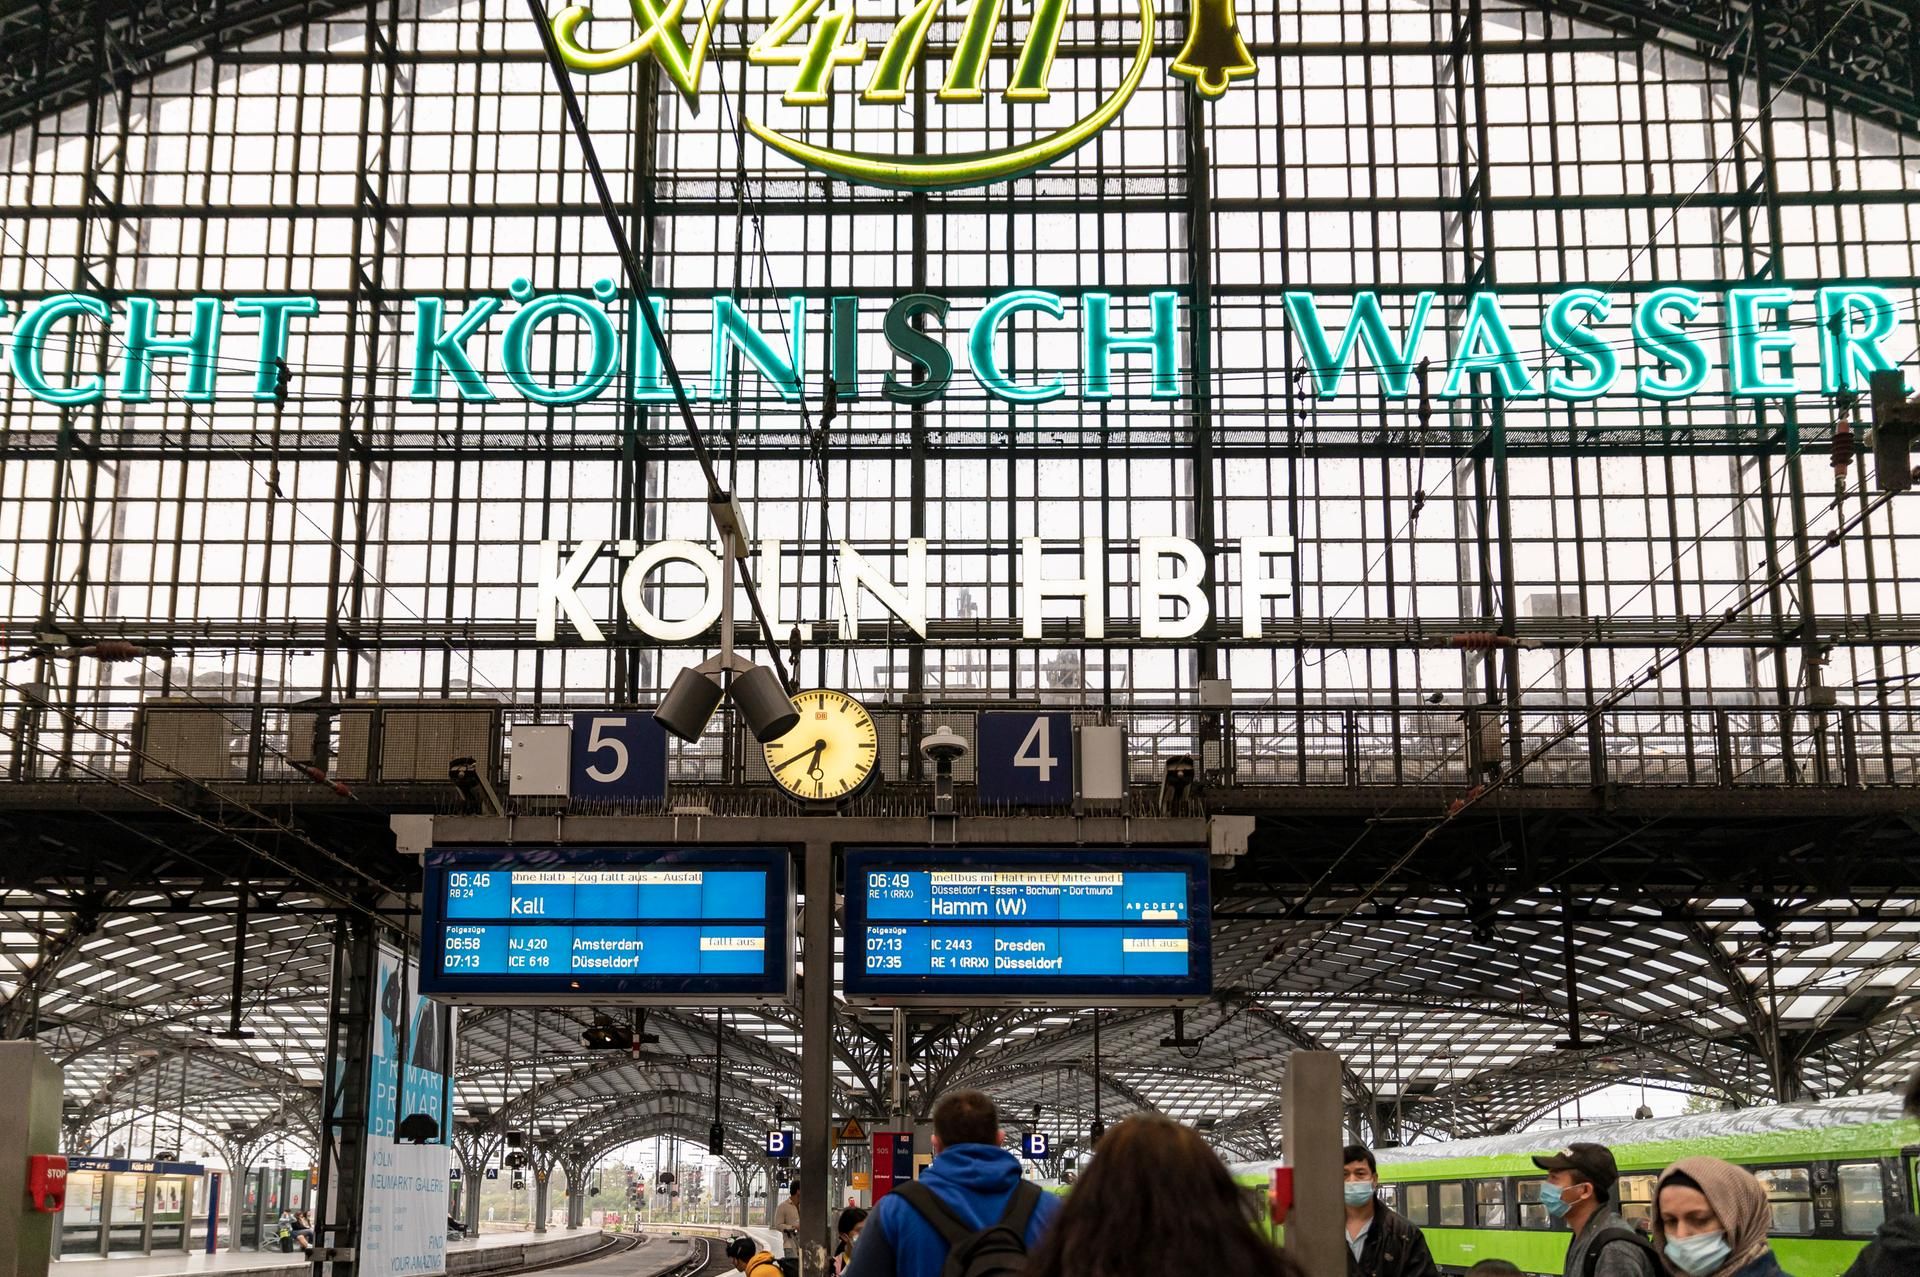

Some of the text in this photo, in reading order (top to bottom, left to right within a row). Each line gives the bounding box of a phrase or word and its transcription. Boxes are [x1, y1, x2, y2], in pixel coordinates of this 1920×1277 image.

[0, 277, 1915, 407] CHT KÖLNISCH WASSER
[535, 536, 1294, 642] KÖLN HBF
[585, 717, 629, 783] 5
[1013, 716, 1058, 781] 4
[450, 873, 490, 888] 06:46
[578, 873, 597, 883] Zug
[869, 873, 910, 888] 06:49
[981, 874, 998, 882] mit
[1002, 873, 1025, 882] Halt
[1027, 874, 1037, 882] in
[1062, 873, 1091, 882] Mitte
[1094, 873, 1114, 882] und
[450, 889, 474, 898] RB 24
[869, 890, 880, 898] RE
[890, 890, 914, 899] (RRX)
[931, 886, 981, 895] Düsseldorf
[990, 887, 1018, 895] Essen
[1026, 887, 1061, 895] Bochum
[1069, 886, 1113, 896] Dortmund
[511, 897, 545, 914] Kall
[931, 898, 1027, 915] Hamm (W)
[446, 926, 486, 934] Folgezüge
[867, 927, 907, 935] Folgezüge
[445, 938, 481, 950] 06:58
[509, 939, 548, 949] NJ 420
[572, 938, 644, 950] Amsterdam
[867, 938, 902, 950] 07:13
[931, 939, 973, 950] IC 2443
[994, 939, 1046, 951] Dresden
[445, 955, 480, 967] 07:13
[508, 956, 550, 967] ICE 618
[572, 956, 640, 968] Düsseldorf
[867, 956, 902, 968] 07:35
[931, 957, 989, 968] RE 1 (RRX)
[994, 956, 1063, 969] Düsseldorf
[769, 1131, 784, 1152] B
[1031, 1134, 1046, 1153] B
[47, 1168, 66, 1178] STOP
